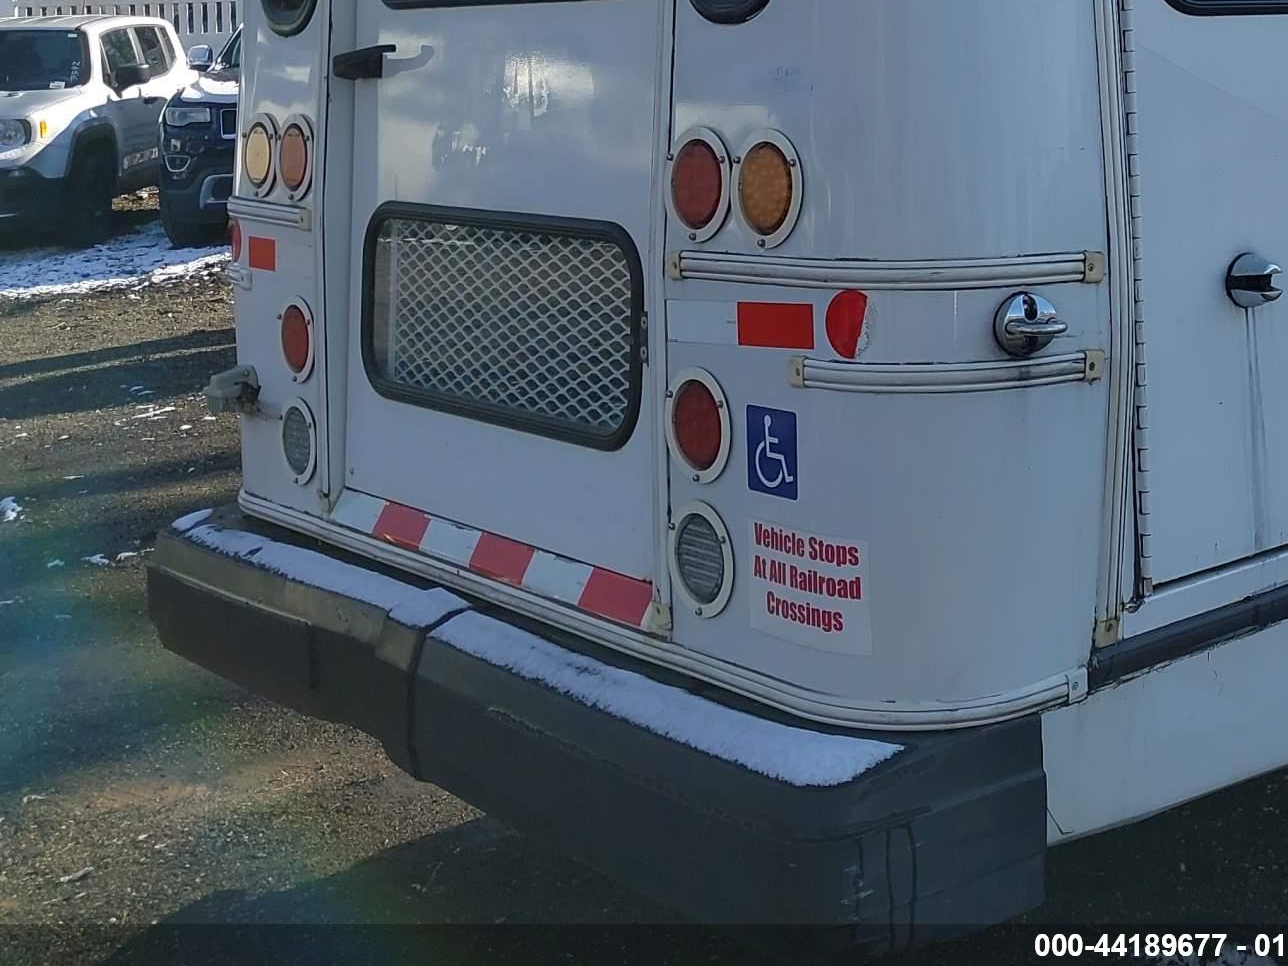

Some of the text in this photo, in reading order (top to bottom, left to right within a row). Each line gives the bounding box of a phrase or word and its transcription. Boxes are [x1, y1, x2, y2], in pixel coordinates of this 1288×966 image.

[753, 521, 859, 566] Vehicle Stops
[753, 554, 862, 600] At All Railroad
[766, 591, 843, 633] Crossings
